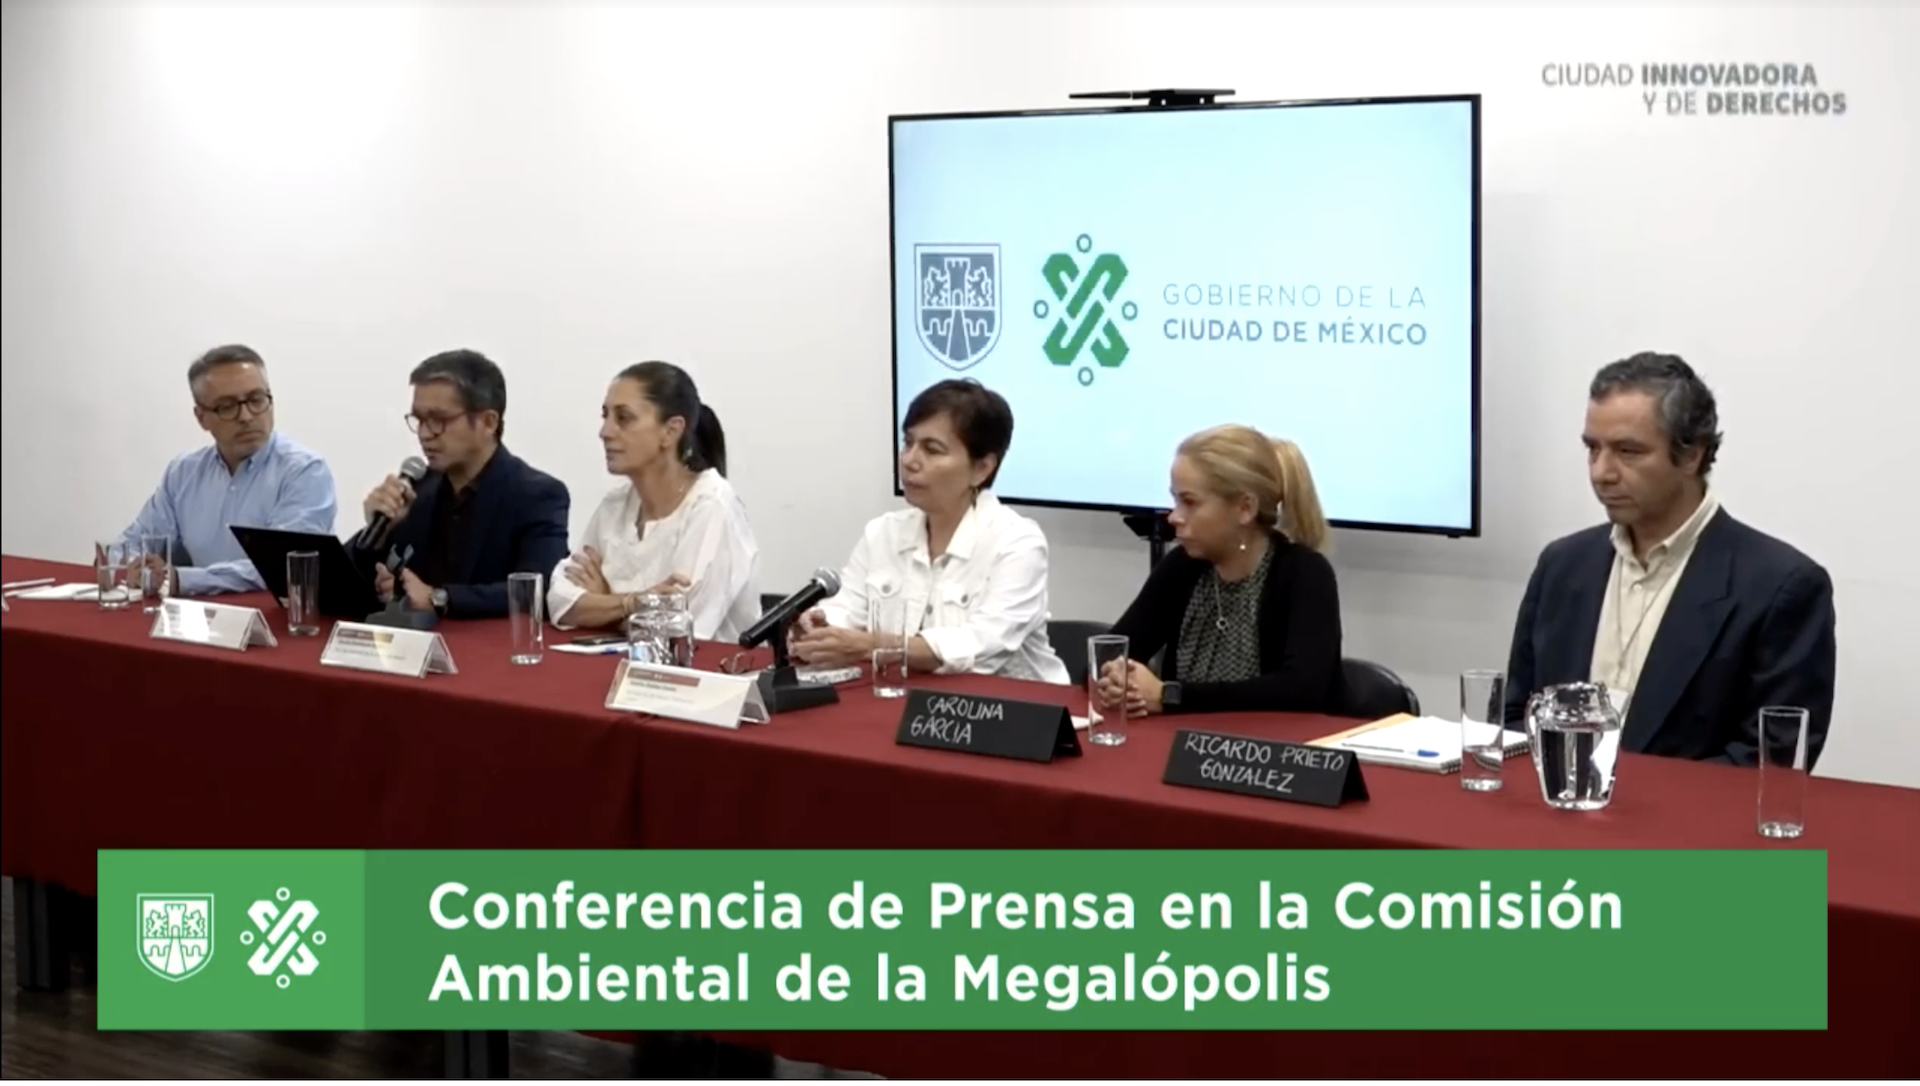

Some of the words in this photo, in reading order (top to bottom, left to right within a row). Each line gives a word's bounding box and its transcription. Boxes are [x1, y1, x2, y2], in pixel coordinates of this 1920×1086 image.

[1163, 283, 1321, 307] GOBIERNO
[1336, 285, 1373, 308] DE
[1389, 286, 1426, 309] LA
[1163, 317, 1263, 342] CIUDAD
[1273, 321, 1308, 343] DE
[1318, 316, 1428, 346] MÉXICO
[926, 695, 1004, 721] CAROLINA
[910, 715, 972, 745] GARCIA
[1185, 733, 1272, 764] RICARDO
[1280, 746, 1345, 772] PRIETO
[1200, 758, 1295, 793] GONZALEZ
